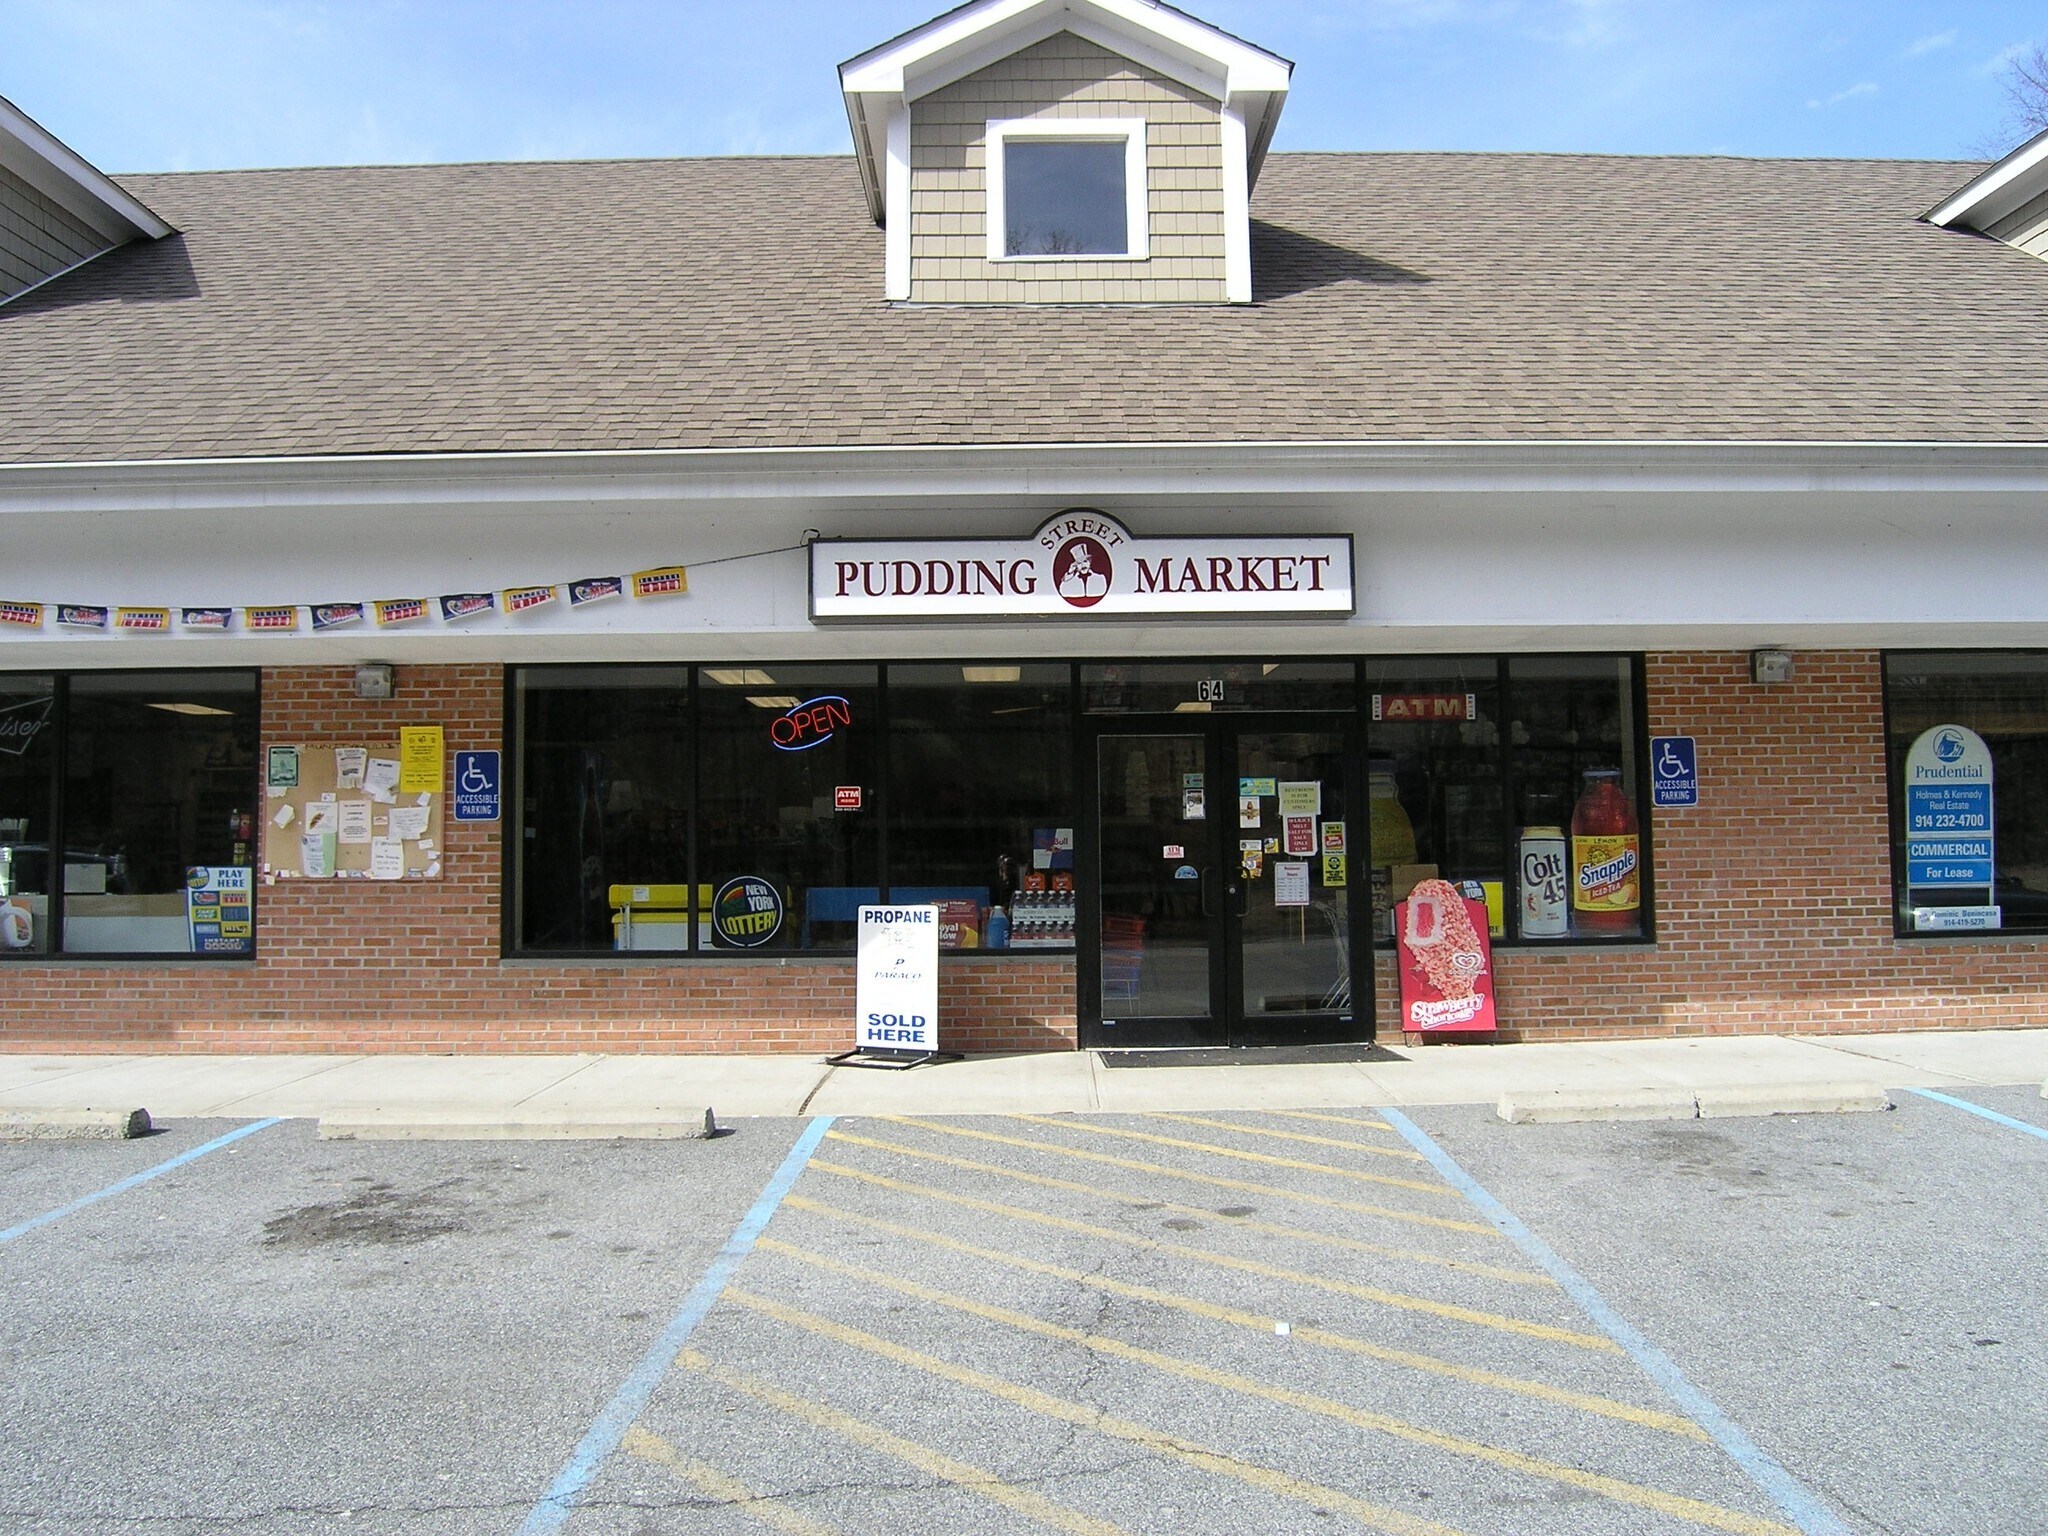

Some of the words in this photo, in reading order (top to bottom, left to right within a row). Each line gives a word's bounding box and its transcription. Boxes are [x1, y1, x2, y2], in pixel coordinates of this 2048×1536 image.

[1039, 517, 1124, 551] STREET
[834, 560, 1037, 597] PUDDING
[1133, 555, 1330, 593] MARKET
[1200, 681, 1222, 700] 64
[1386, 698, 1461, 717] ATM
[771, 701, 850, 744] OPEN
[1915, 764, 1984, 779] Prudential
[1655, 780, 1696, 790] ACCESSIBLE
[456, 794, 498, 804] ACCESSIBLE
[838, 790, 859, 798] ATM
[1661, 790, 1690, 801] PARKING
[1943, 789, 1951, 799] &
[1951, 788, 1983, 800] Kennedy
[462, 805, 492, 815] PARKING
[1929, 801, 1946, 810] Real
[1946, 801, 1970, 810] Estate
[1915, 814, 1934, 828] 914
[1935, 814, 1985, 828] 232-4700
[1911, 843, 1989, 857] COMMERCIAL
[218, 869, 244, 878] PLAY
[1523, 852, 1562, 888] Colt
[1580, 850, 1634, 886] Snapple
[1926, 866, 1943, 878] For
[1944, 866, 1974, 878] Lease
[217, 879, 246, 888] HERE
[745, 884, 768, 896] NEW
[1463, 880, 1479, 889] NEW
[1543, 876, 1566, 905] 45
[1592, 887, 1608, 897] ICED
[1608, 882, 1621, 893] TEA
[1465, 888, 1484, 899] YORK
[747, 896, 775, 912] YORK
[721, 910, 777, 935] LOTTERY
[864, 910, 932, 924] PROPANE
[938, 922, 959, 935] oyal
[874, 971, 922, 979] PARACO
[867, 1013, 926, 1028] SOLD
[867, 1028, 926, 1043] HERE
